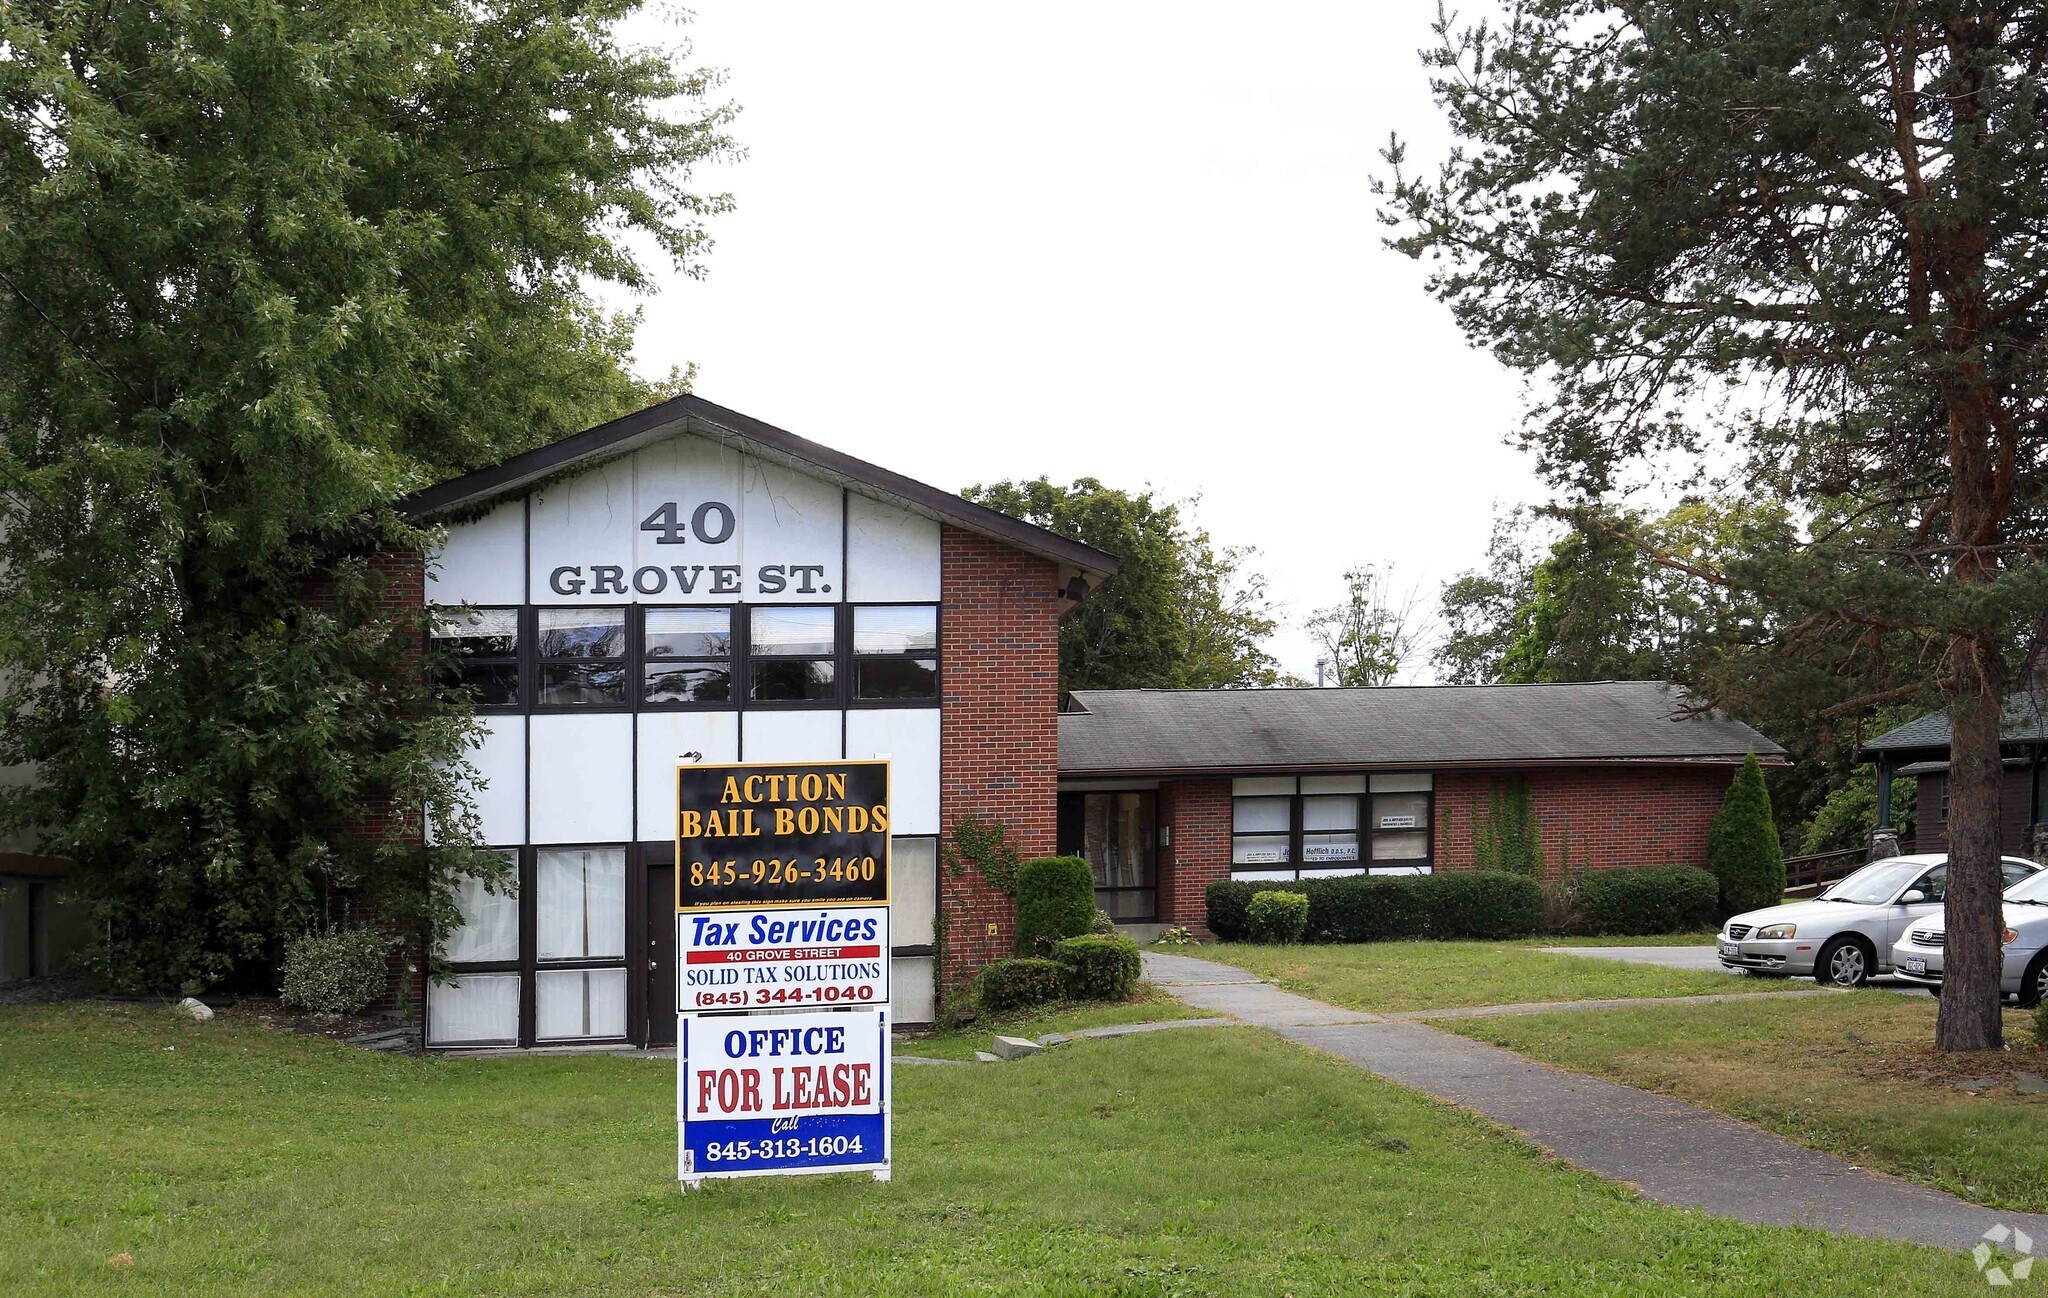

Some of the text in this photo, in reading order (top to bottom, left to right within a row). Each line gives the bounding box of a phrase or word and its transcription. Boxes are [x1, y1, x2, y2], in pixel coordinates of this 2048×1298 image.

[641, 501, 736, 545] 40
[549, 564, 832, 596] GROVE ST.
[720, 773, 847, 804] ACTION
[681, 804, 888, 839] BAIL BONDS
[690, 856, 876, 888] 845-926-3460
[692, 912, 878, 946] Tax Services
[726, 948, 842, 962] 40 GROVE STREET
[686, 962, 880, 987] SOLID TAX SOLUTIONS
[695, 985, 874, 1007] (845) 344-1040
[724, 1026, 845, 1059] OFFICE
[697, 1062, 871, 1114] FOR LEASE
[771, 1114, 800, 1135] Call
[706, 1134, 863, 1163] 845-313-1604
